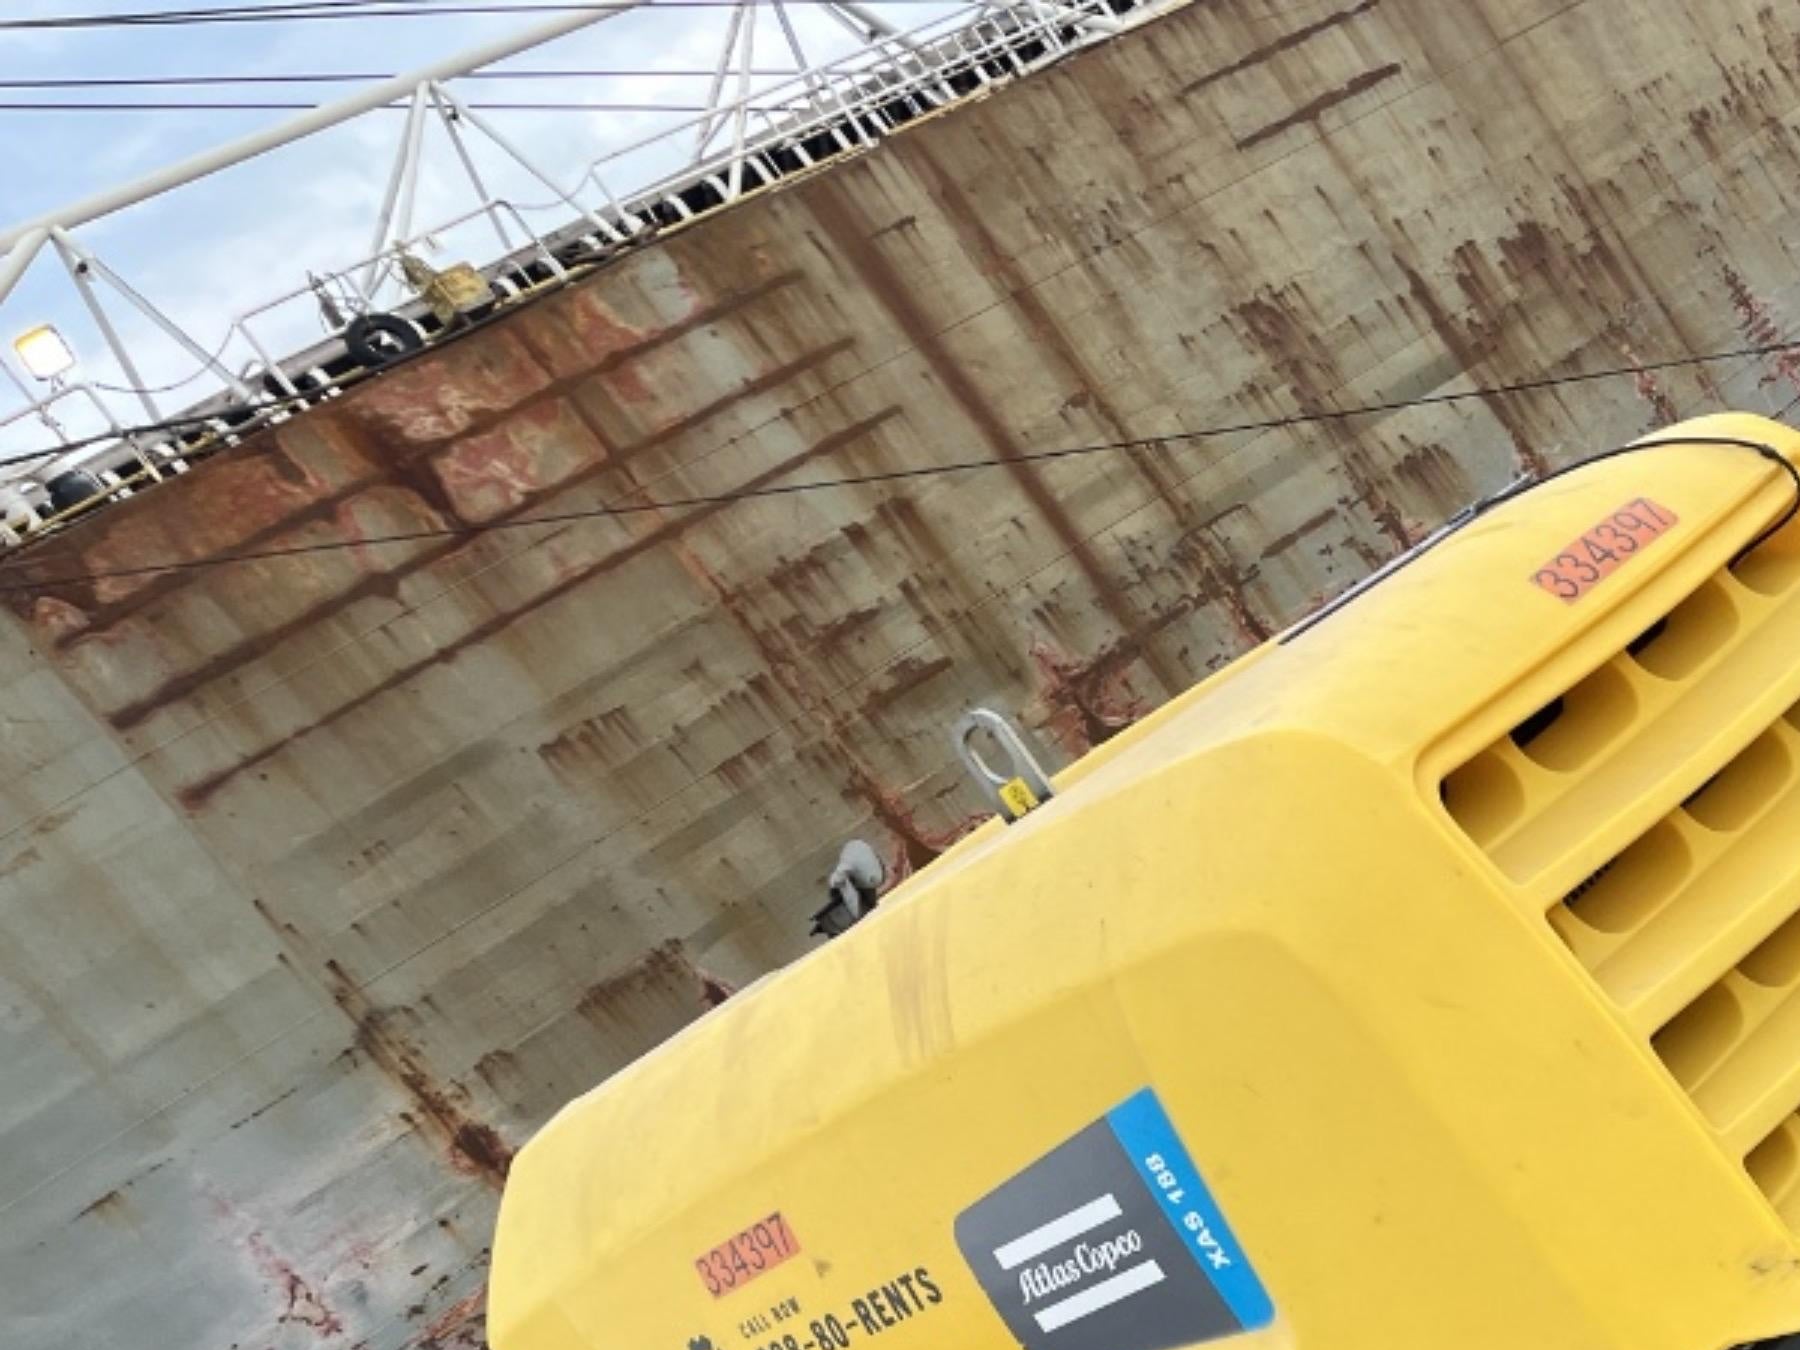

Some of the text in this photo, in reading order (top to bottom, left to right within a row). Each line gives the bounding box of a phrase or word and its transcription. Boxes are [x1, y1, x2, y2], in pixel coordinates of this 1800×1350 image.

[1533, 498, 1671, 599] 334397
[695, 1211, 791, 1297] 334397
[1145, 1153, 1231, 1270] XAS 188
